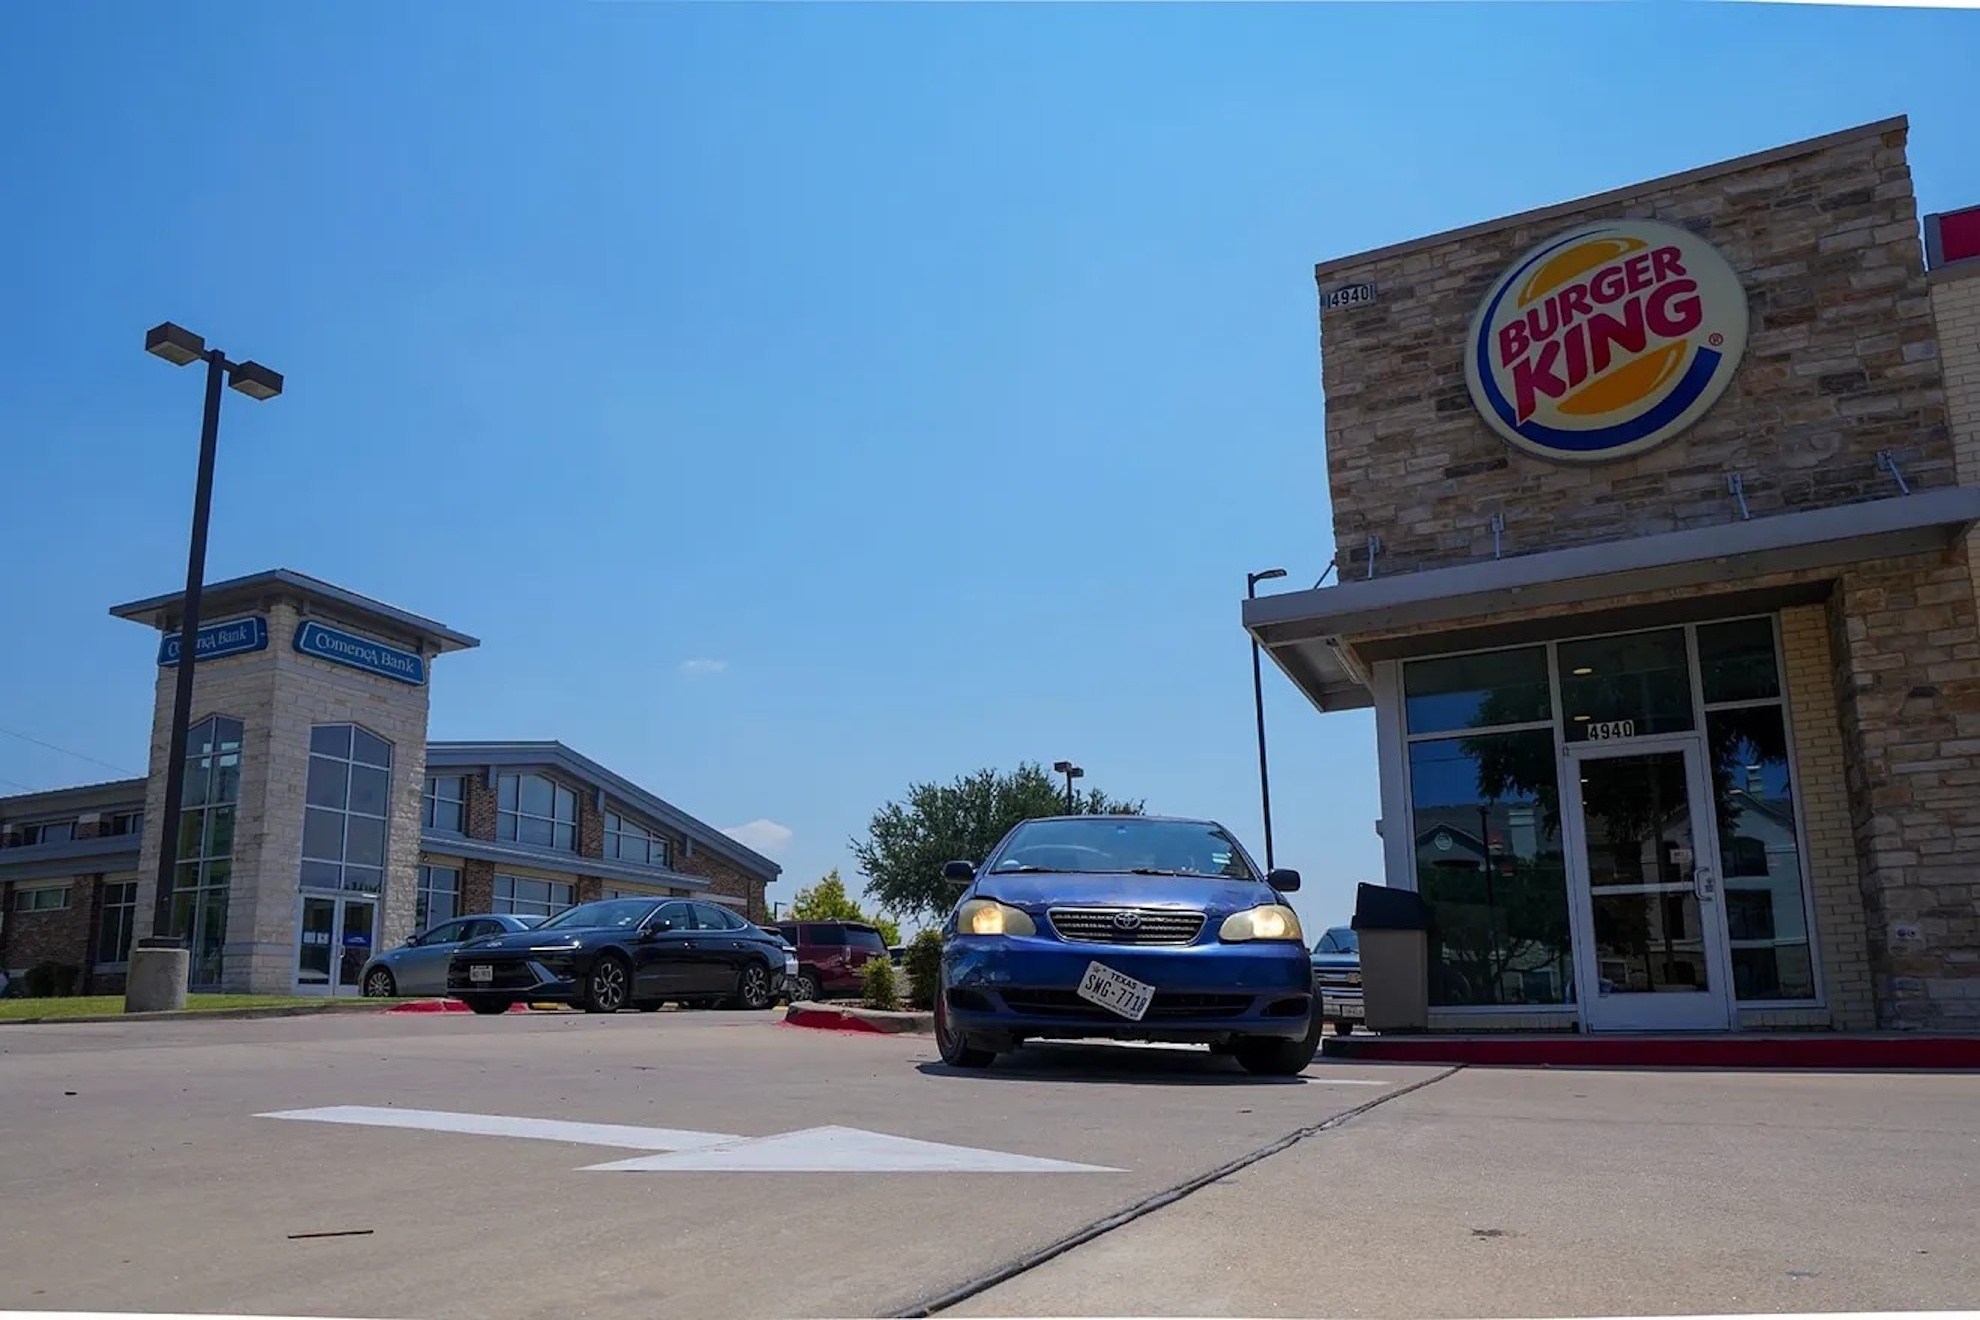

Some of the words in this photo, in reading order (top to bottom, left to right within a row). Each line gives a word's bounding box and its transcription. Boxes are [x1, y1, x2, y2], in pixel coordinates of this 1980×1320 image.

[1331, 286, 1369, 306] 4940
[1498, 246, 1687, 368] BURGER
[1512, 279, 1703, 423] KING
[218, 626, 247, 646] Bank
[381, 651, 415, 674] Bank
[1590, 721, 1632, 740] 4940
[1111, 972, 1138, 990] TEXAS
